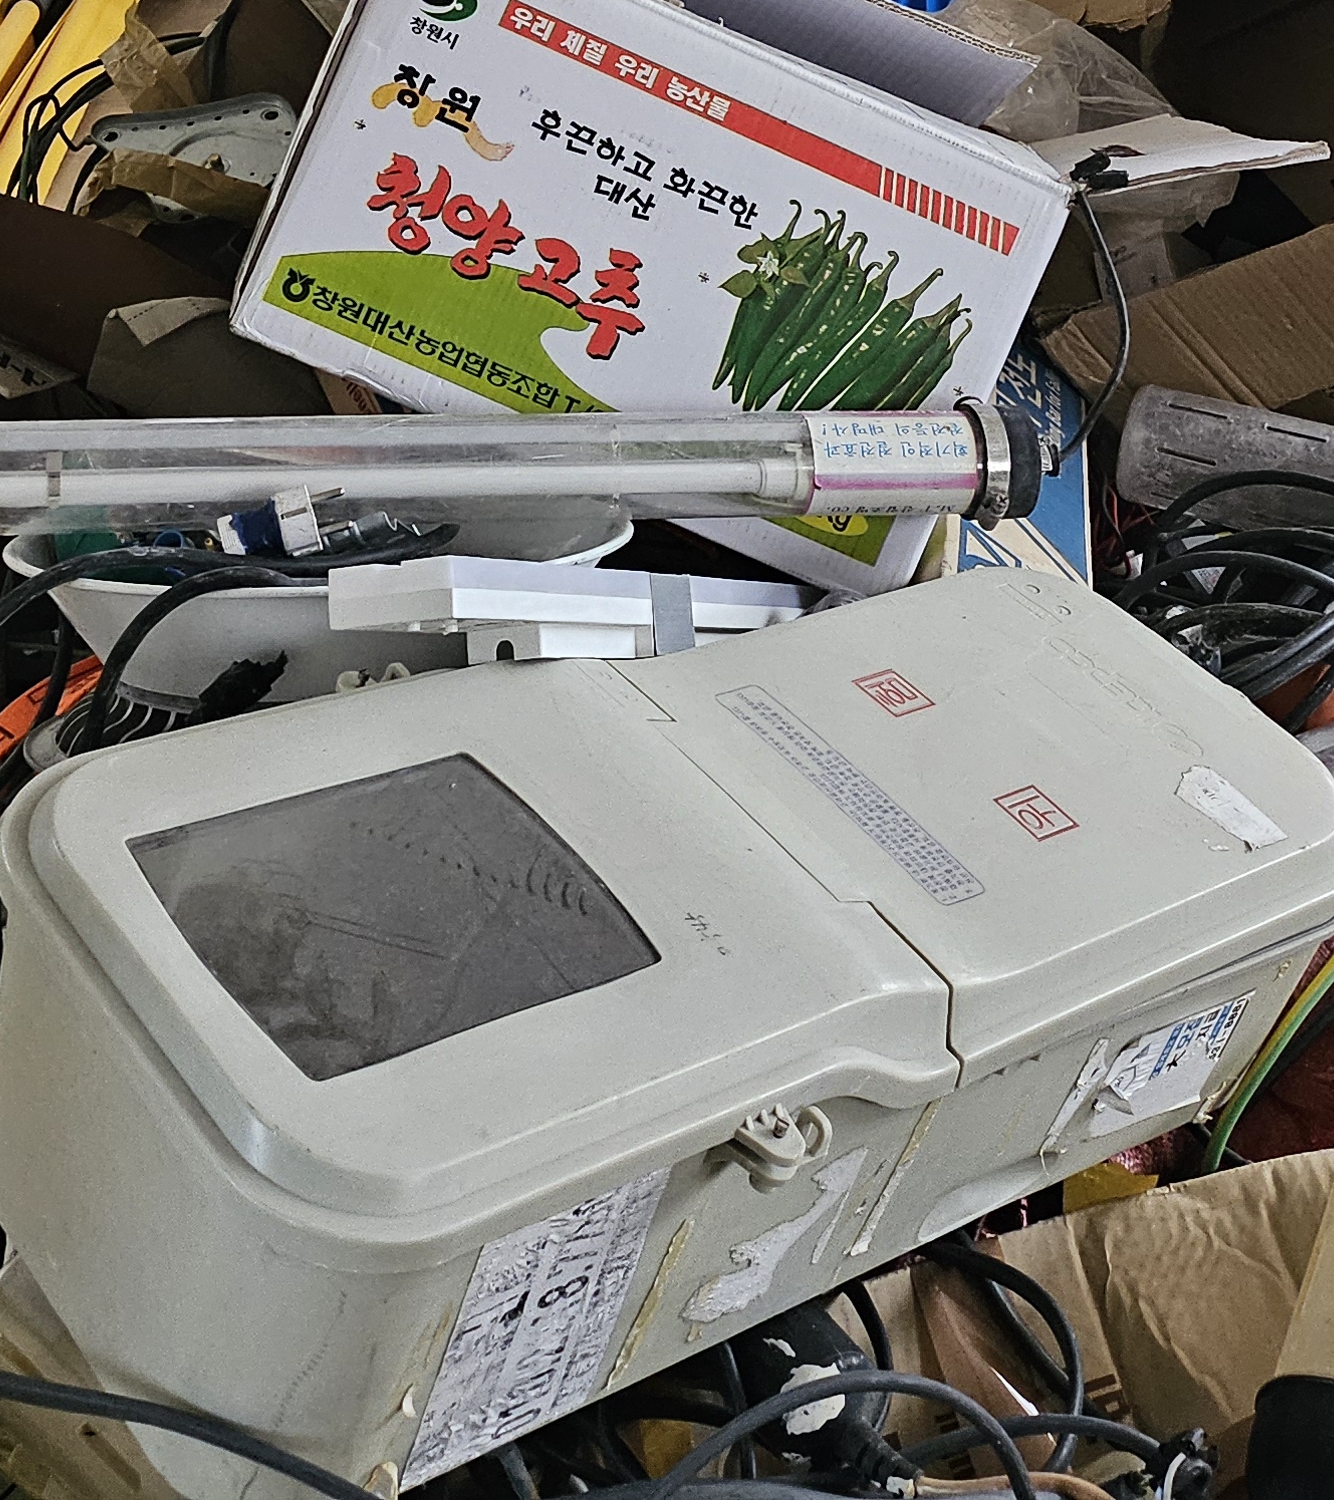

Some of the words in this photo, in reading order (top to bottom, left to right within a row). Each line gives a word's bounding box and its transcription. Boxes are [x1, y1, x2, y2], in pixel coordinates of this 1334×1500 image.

[409, 15, 460, 50] 창원시
[509, 5, 555, 43] 우리
[559, 29, 608, 67] 체질
[614, 53, 660, 89] 우리
[665, 75, 732, 122] 농산물
[393, 62, 482, 133] 창원
[530, 108, 657, 182] 후끈하고
[662, 166, 759, 231] 화끈한
[592, 173, 657, 222] 대산
[312, 284, 562, 411] 창원대산농업협동조합
[821, 422, 886, 437] 대명사!
[823, 440, 893, 459] 절전효과
[899, 440, 969, 458] 획기적인
